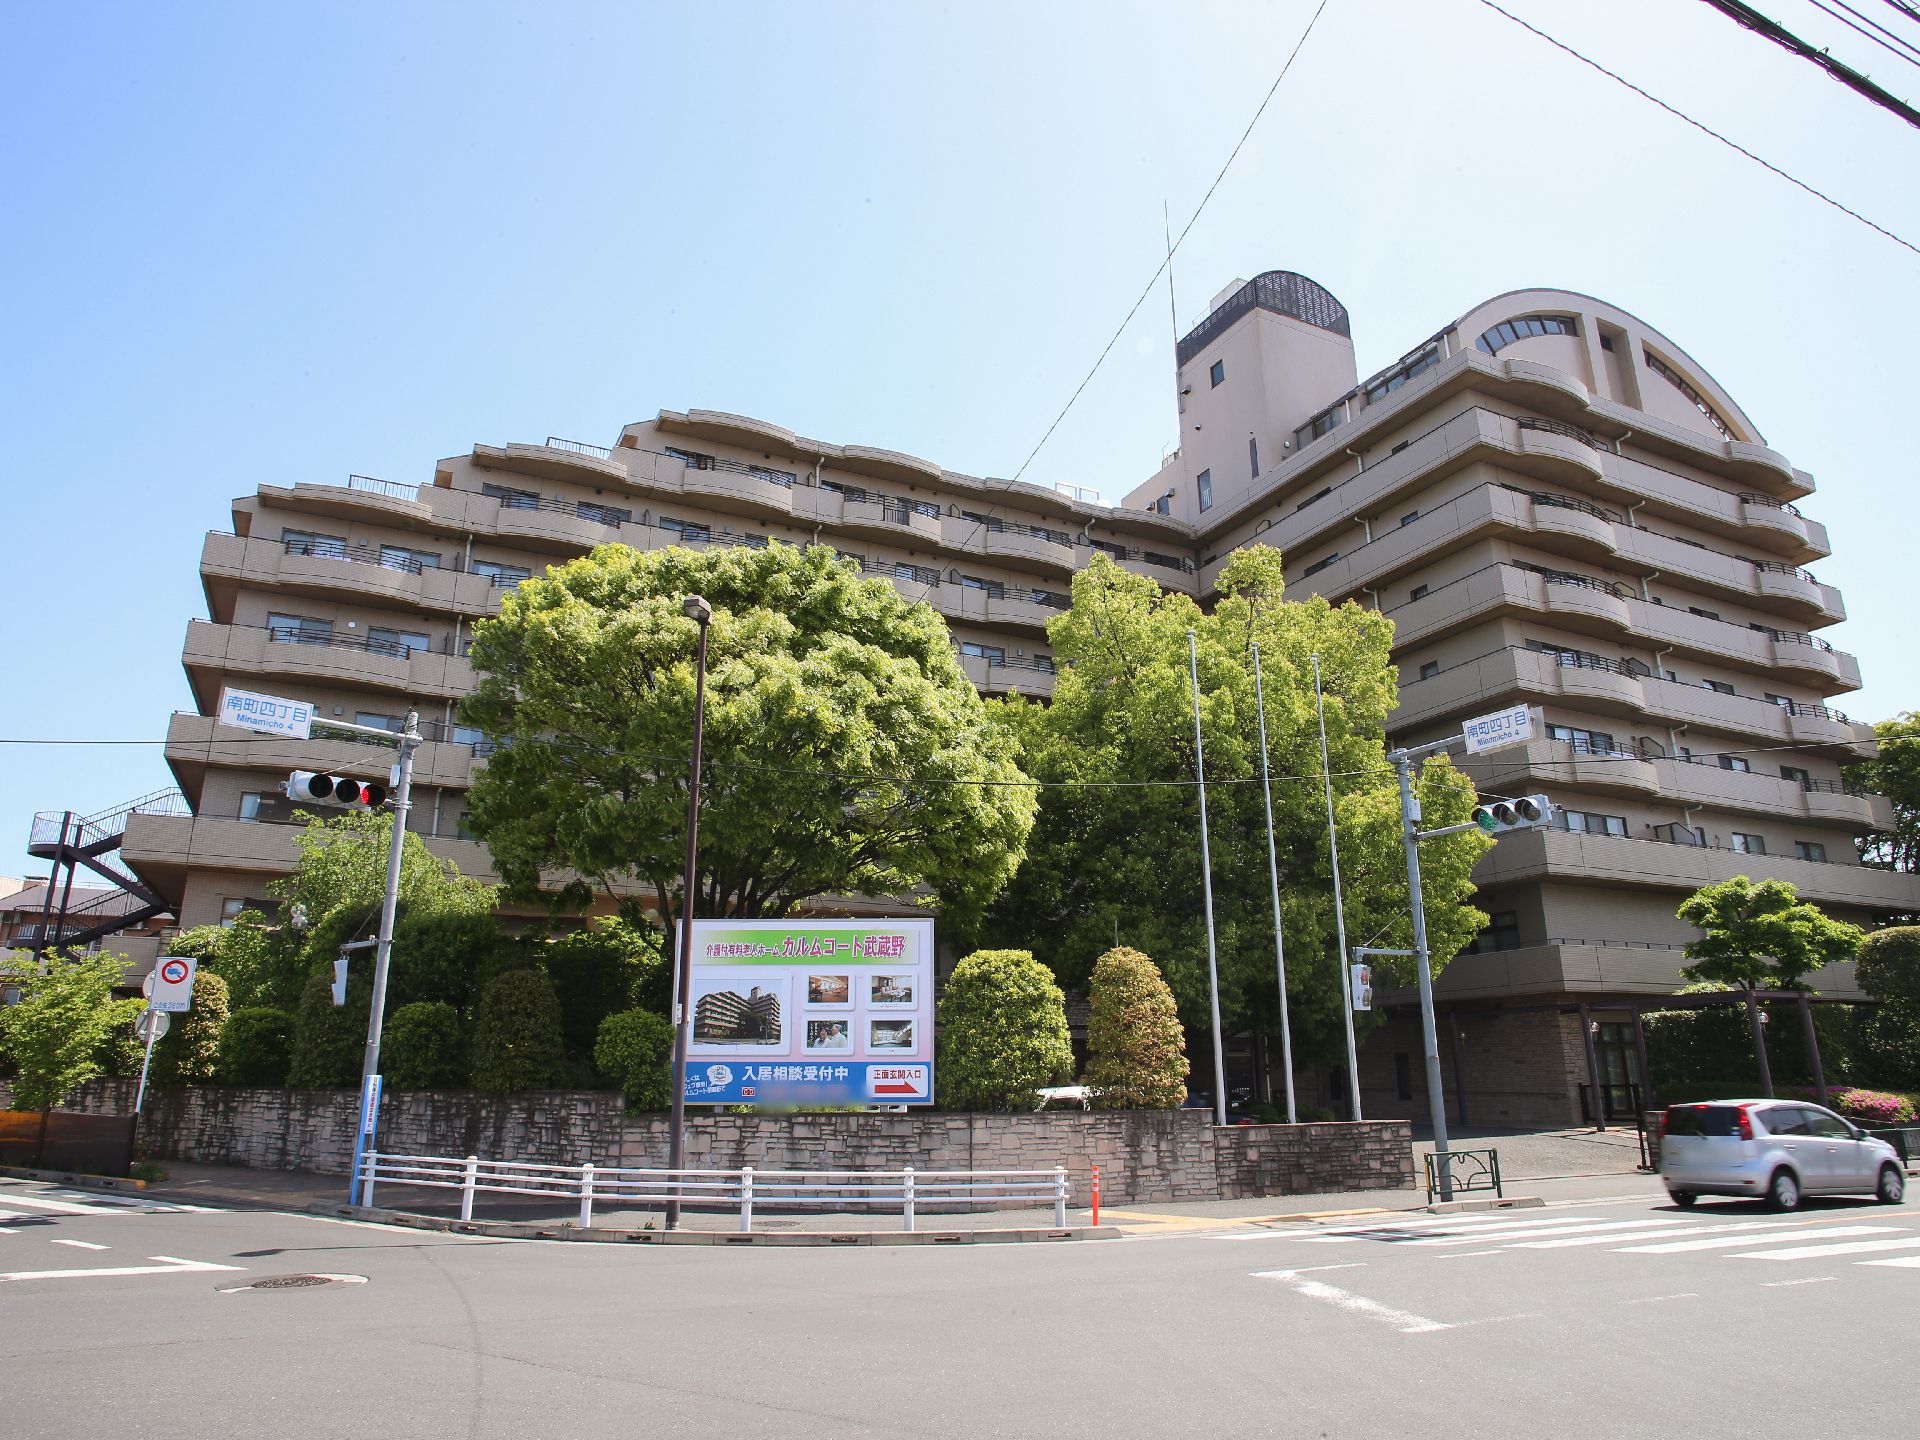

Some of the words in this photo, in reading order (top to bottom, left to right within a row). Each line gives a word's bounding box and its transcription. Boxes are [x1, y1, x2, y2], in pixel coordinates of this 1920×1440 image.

[227, 696, 307, 722] 南町四丁目
[236, 713, 285, 729] Minamicho
[287, 722, 294, 731] 4
[1467, 711, 1526, 739] 南町四丁目
[1477, 731, 1513, 747] Minamicho
[1514, 728, 1520, 736] 4
[706, 943, 779, 957] 介護付有料老人ホーム
[781, 936, 905, 958] カルムコート武蔵野
[742, 1066, 849, 1081] 入居相談受付中
[873, 1069, 922, 1080] 正面玄関入口
